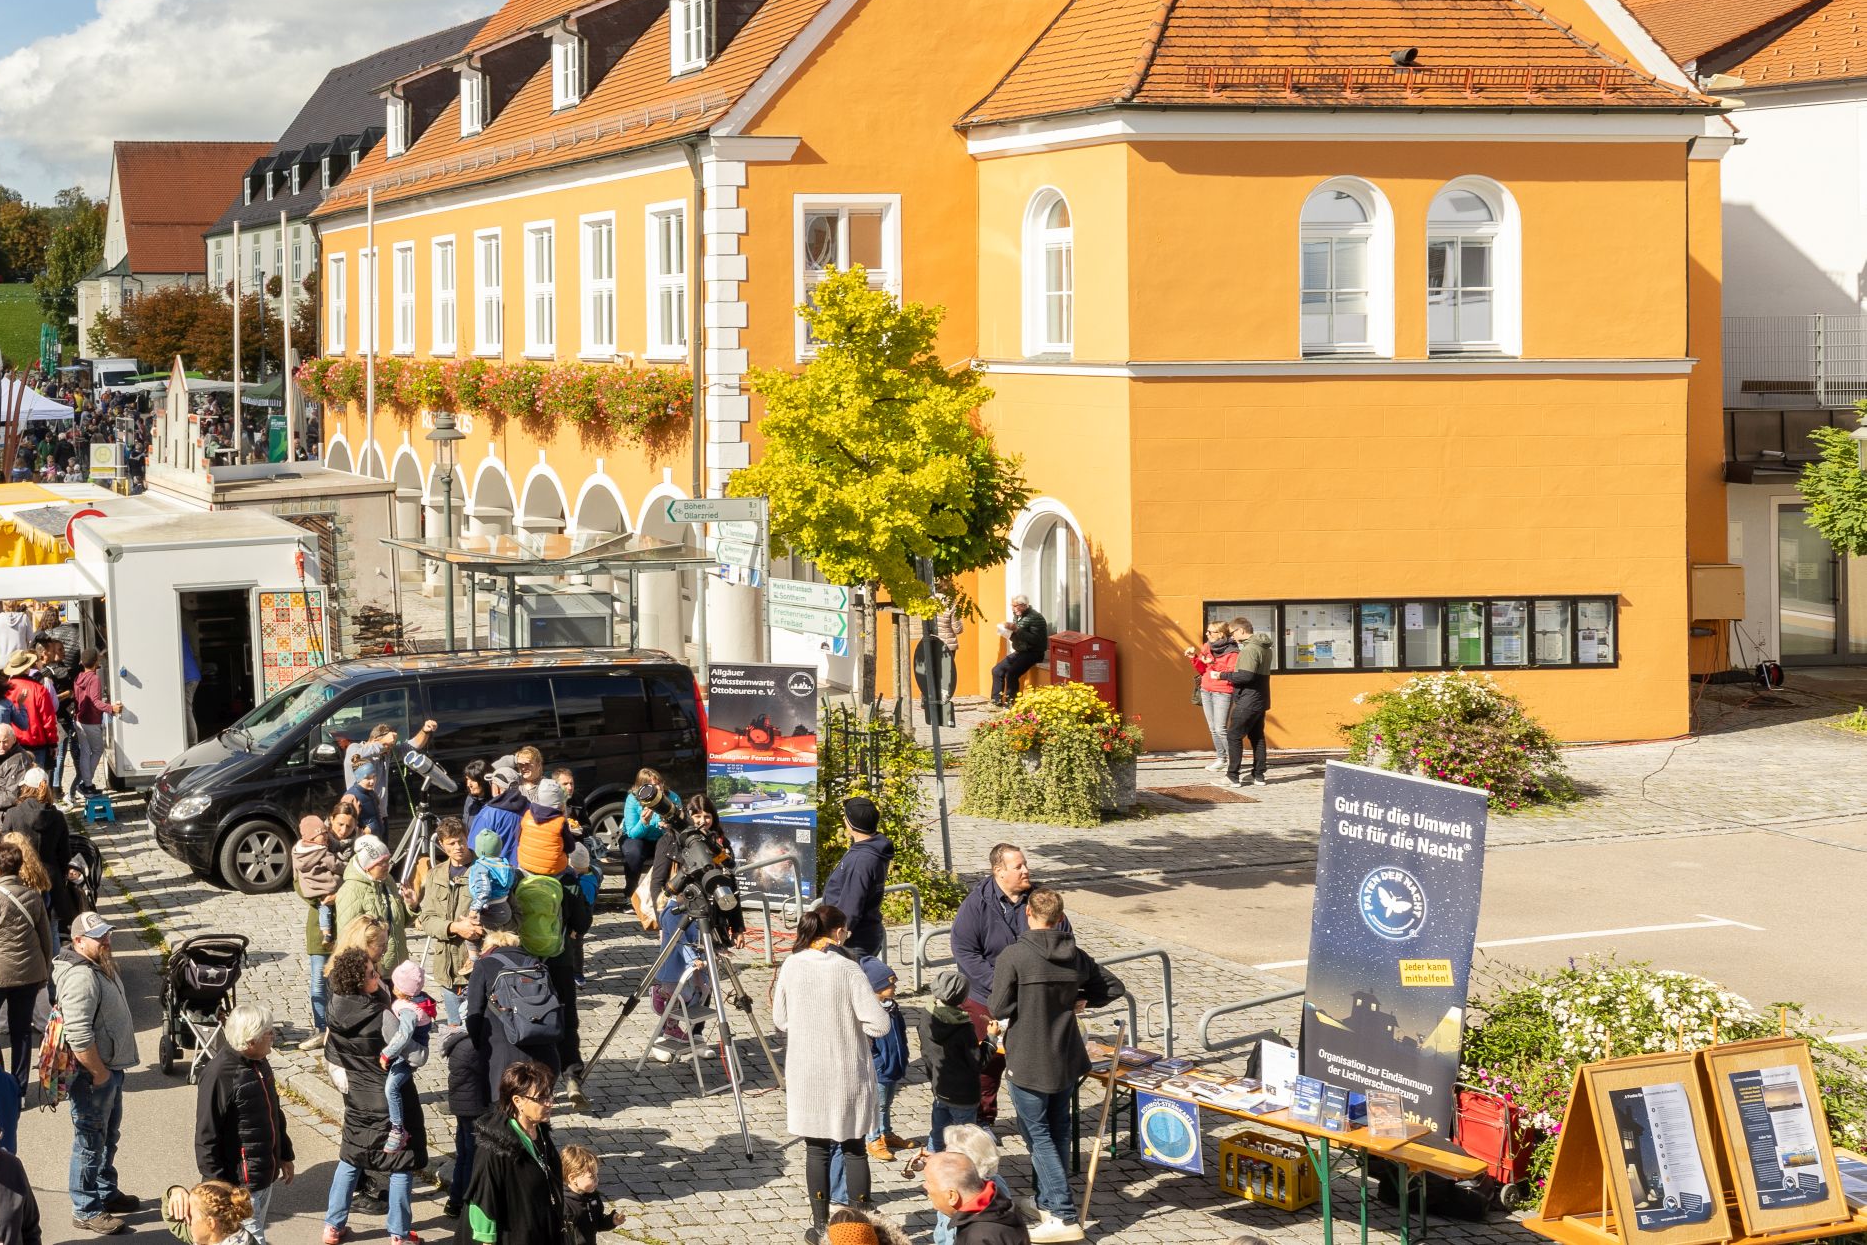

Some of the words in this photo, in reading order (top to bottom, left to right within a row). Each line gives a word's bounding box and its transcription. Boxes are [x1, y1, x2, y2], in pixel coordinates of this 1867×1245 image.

[684, 502, 706, 510] Böhen
[684, 511, 719, 520] Ollarzried
[779, 592, 807, 602] Sontheim
[780, 618, 803, 628] Freibad
[711, 668, 745, 677] Allgäuer
[711, 678, 775, 687] Volkssternwarte
[711, 687, 757, 695] Ottobeuren
[1335, 796, 1360, 816] Gut
[1362, 801, 1385, 820] für
[1387, 807, 1410, 826] die
[1414, 812, 1473, 839] Umwelt
[1338, 820, 1363, 839] Gut
[1366, 825, 1388, 844] für
[1390, 831, 1414, 850] die
[1363, 875, 1382, 911] PATEN
[1380, 871, 1404, 883] DER
[1403, 877, 1423, 918] NACHT
[1404, 962, 1425, 971] Jeder
[1427, 962, 1447, 971] kann
[1405, 974, 1449, 983] mithelfen!
[1318, 1048, 1366, 1071] Organisation
[1367, 1064, 1381, 1076] zur
[1381, 1068, 1433, 1095] Eindämmung
[1328, 1064, 1341, 1076] der
[1342, 1068, 1420, 1104] Lichtverschmutzung
